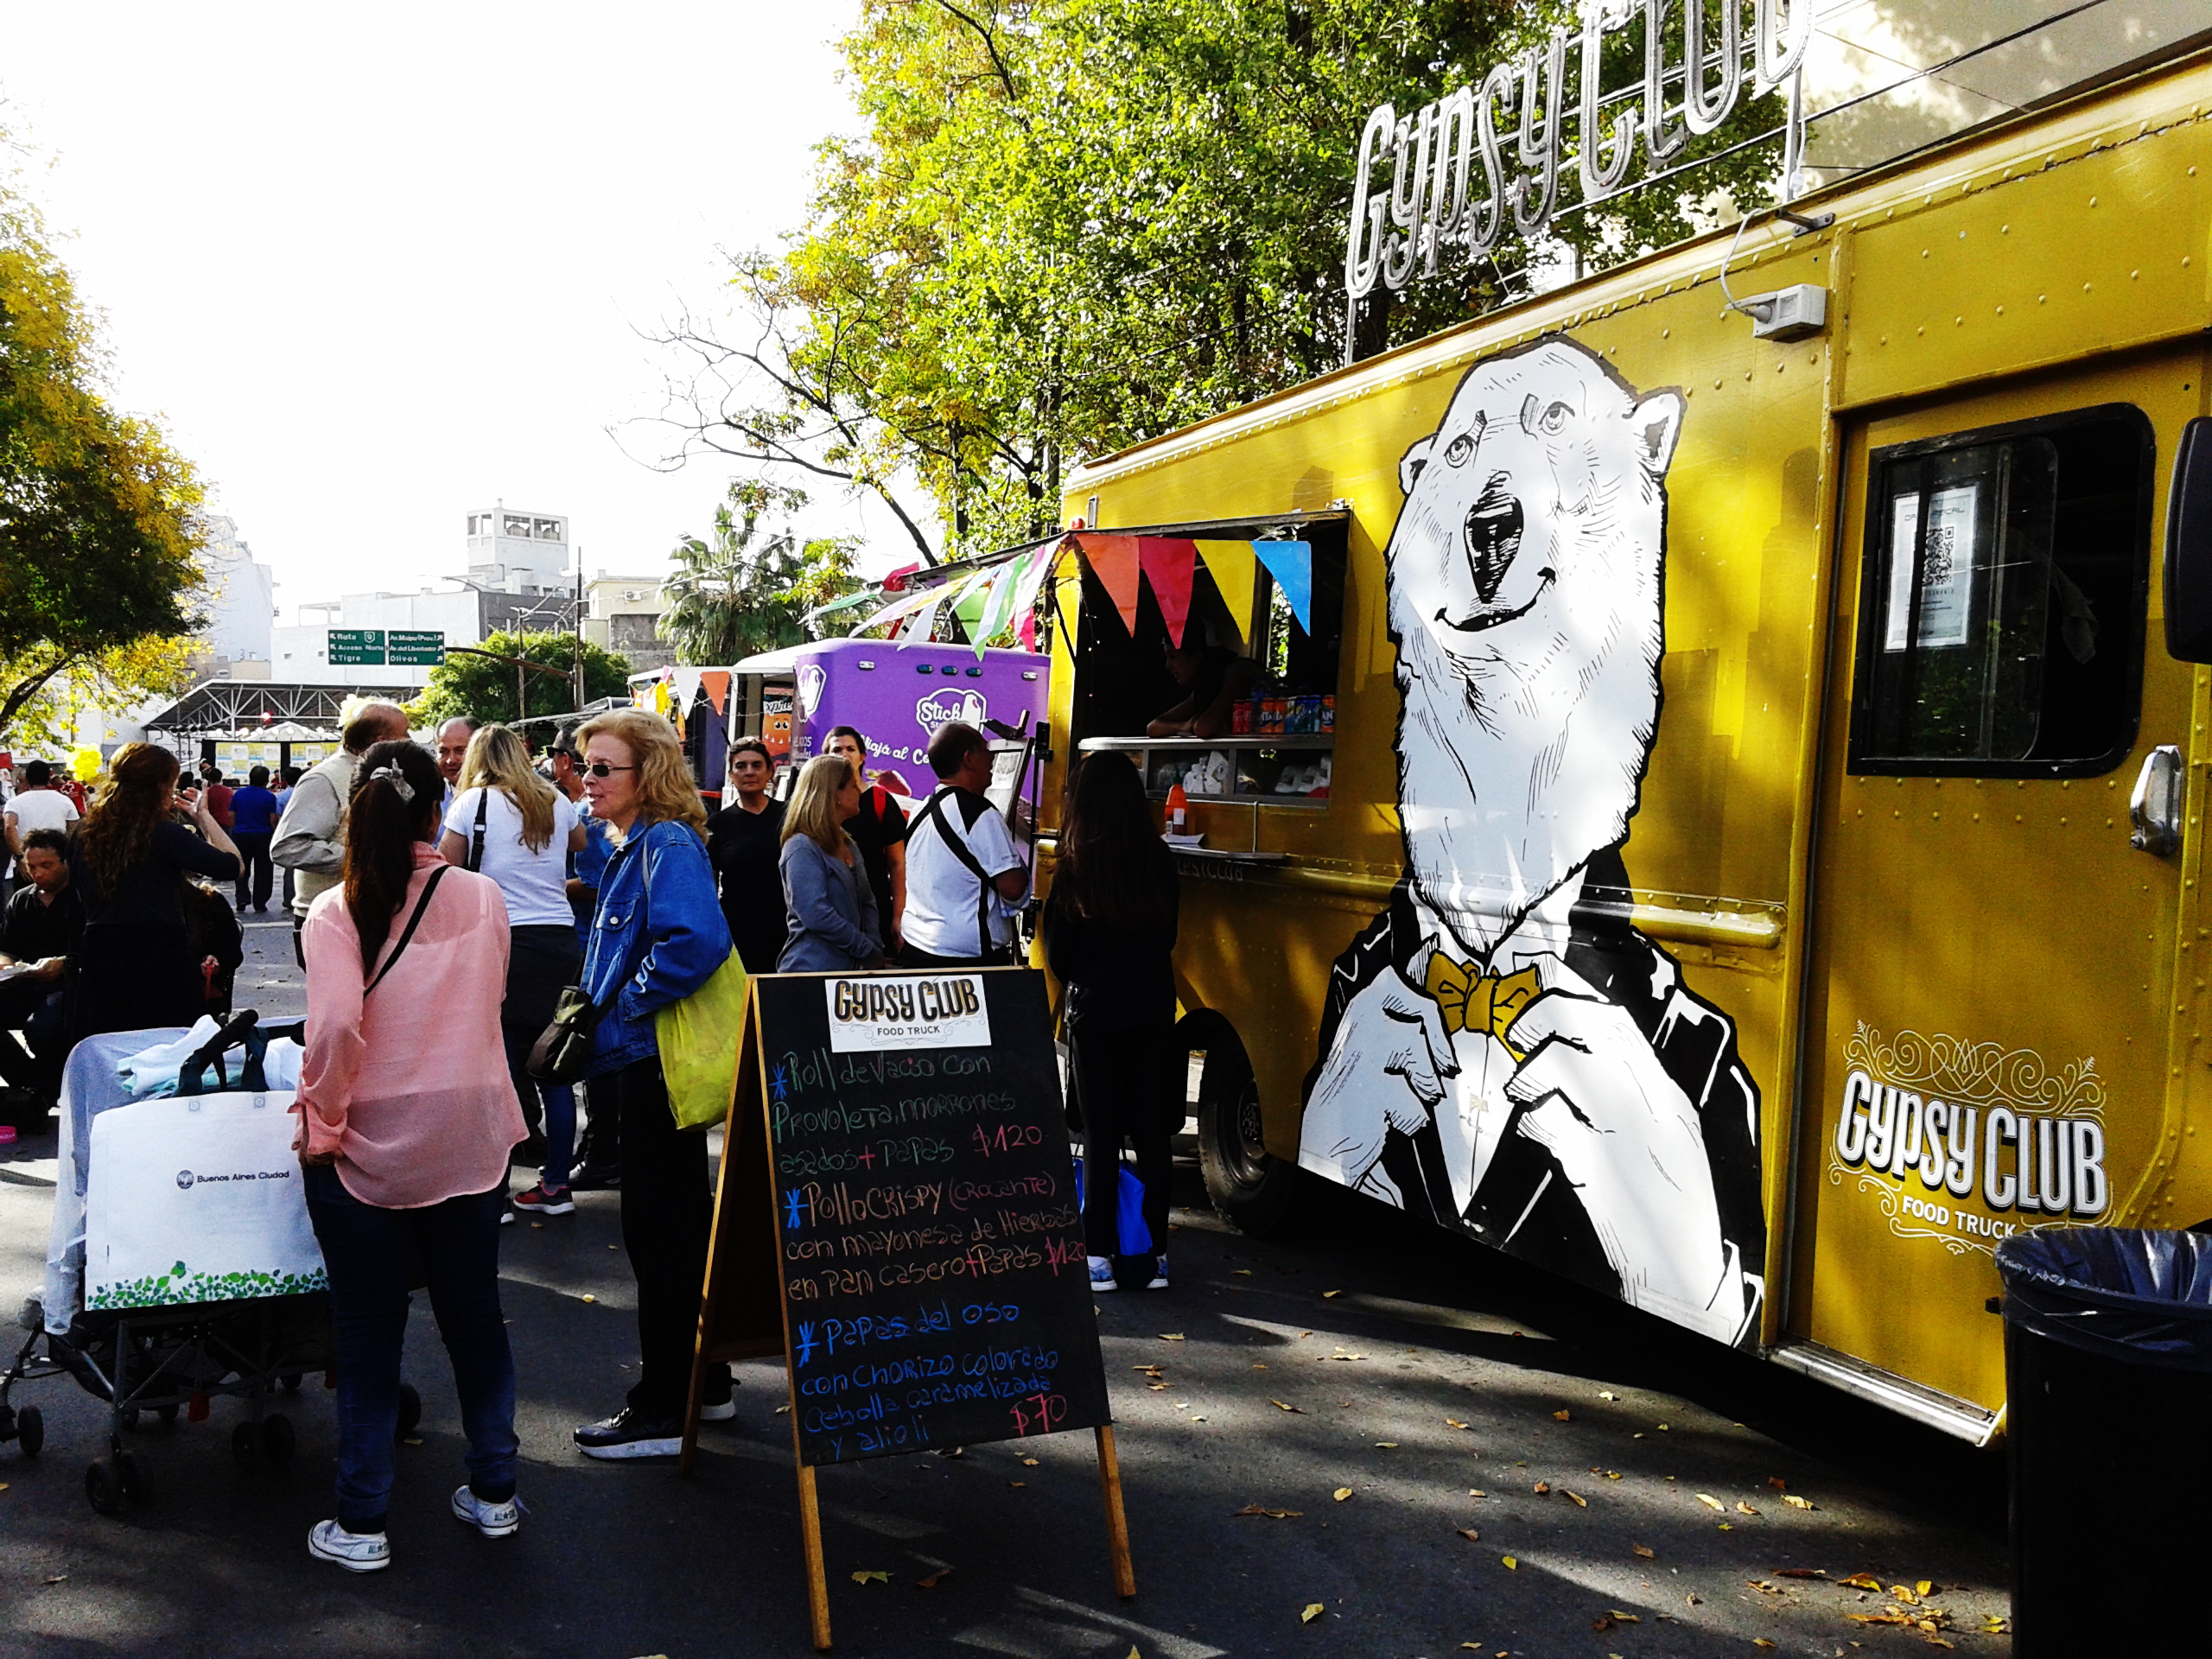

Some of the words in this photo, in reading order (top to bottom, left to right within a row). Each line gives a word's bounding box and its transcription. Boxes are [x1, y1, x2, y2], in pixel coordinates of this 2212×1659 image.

[921, 701, 961, 721] Stick
[893, 746, 909, 760] al
[835, 979, 916, 1022] GYPSY
[918, 977, 981, 1021] CLUB
[877, 1027, 905, 1036] FOOD
[907, 1025, 941, 1035] TRUCK
[783, 1047, 836, 1092] Roll
[973, 1123, 1043, 1158] $120
[1837, 1069, 1979, 1197] GYPSY
[1983, 1105, 2107, 1216] CLUB
[232, 1173, 256, 1181] Aires
[258, 1170, 289, 1179] Ciudad
[1902, 1195, 1949, 1226] FOOD
[1955, 1211, 2018, 1239] TRUCK
[1009, 1393, 1067, 1436] $70
